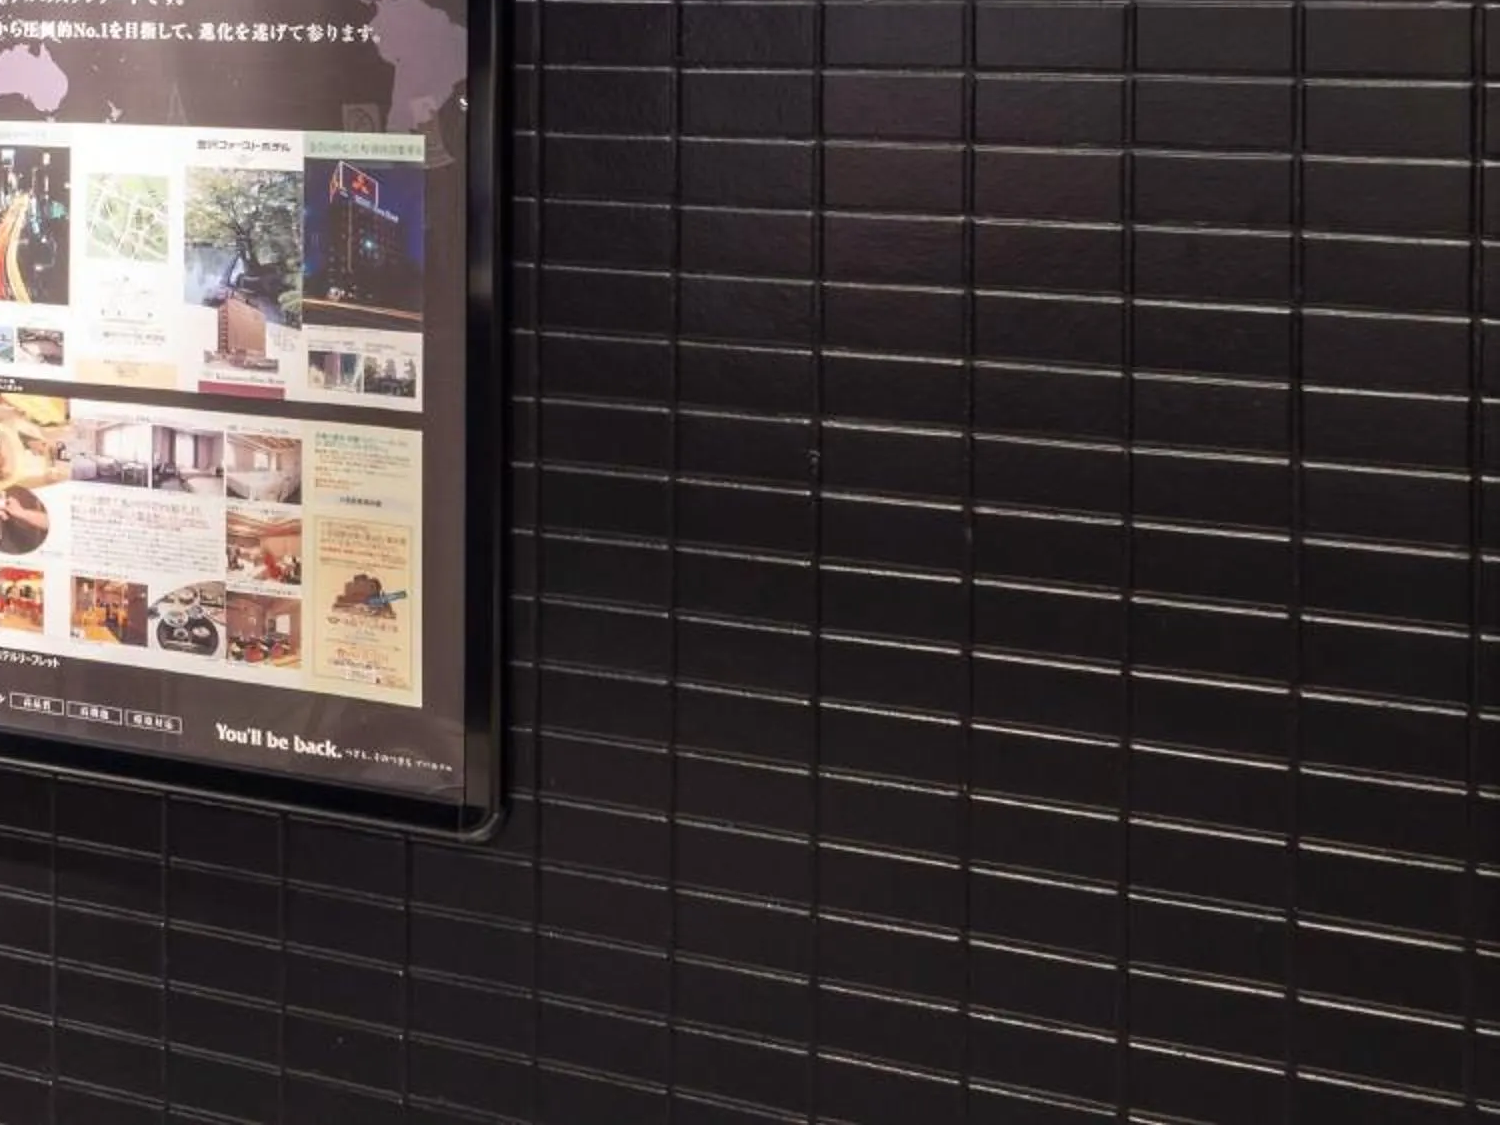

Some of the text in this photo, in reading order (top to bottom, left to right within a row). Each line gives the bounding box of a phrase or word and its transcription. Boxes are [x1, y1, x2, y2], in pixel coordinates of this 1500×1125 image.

[215, 722, 343, 759] You'll be back.
